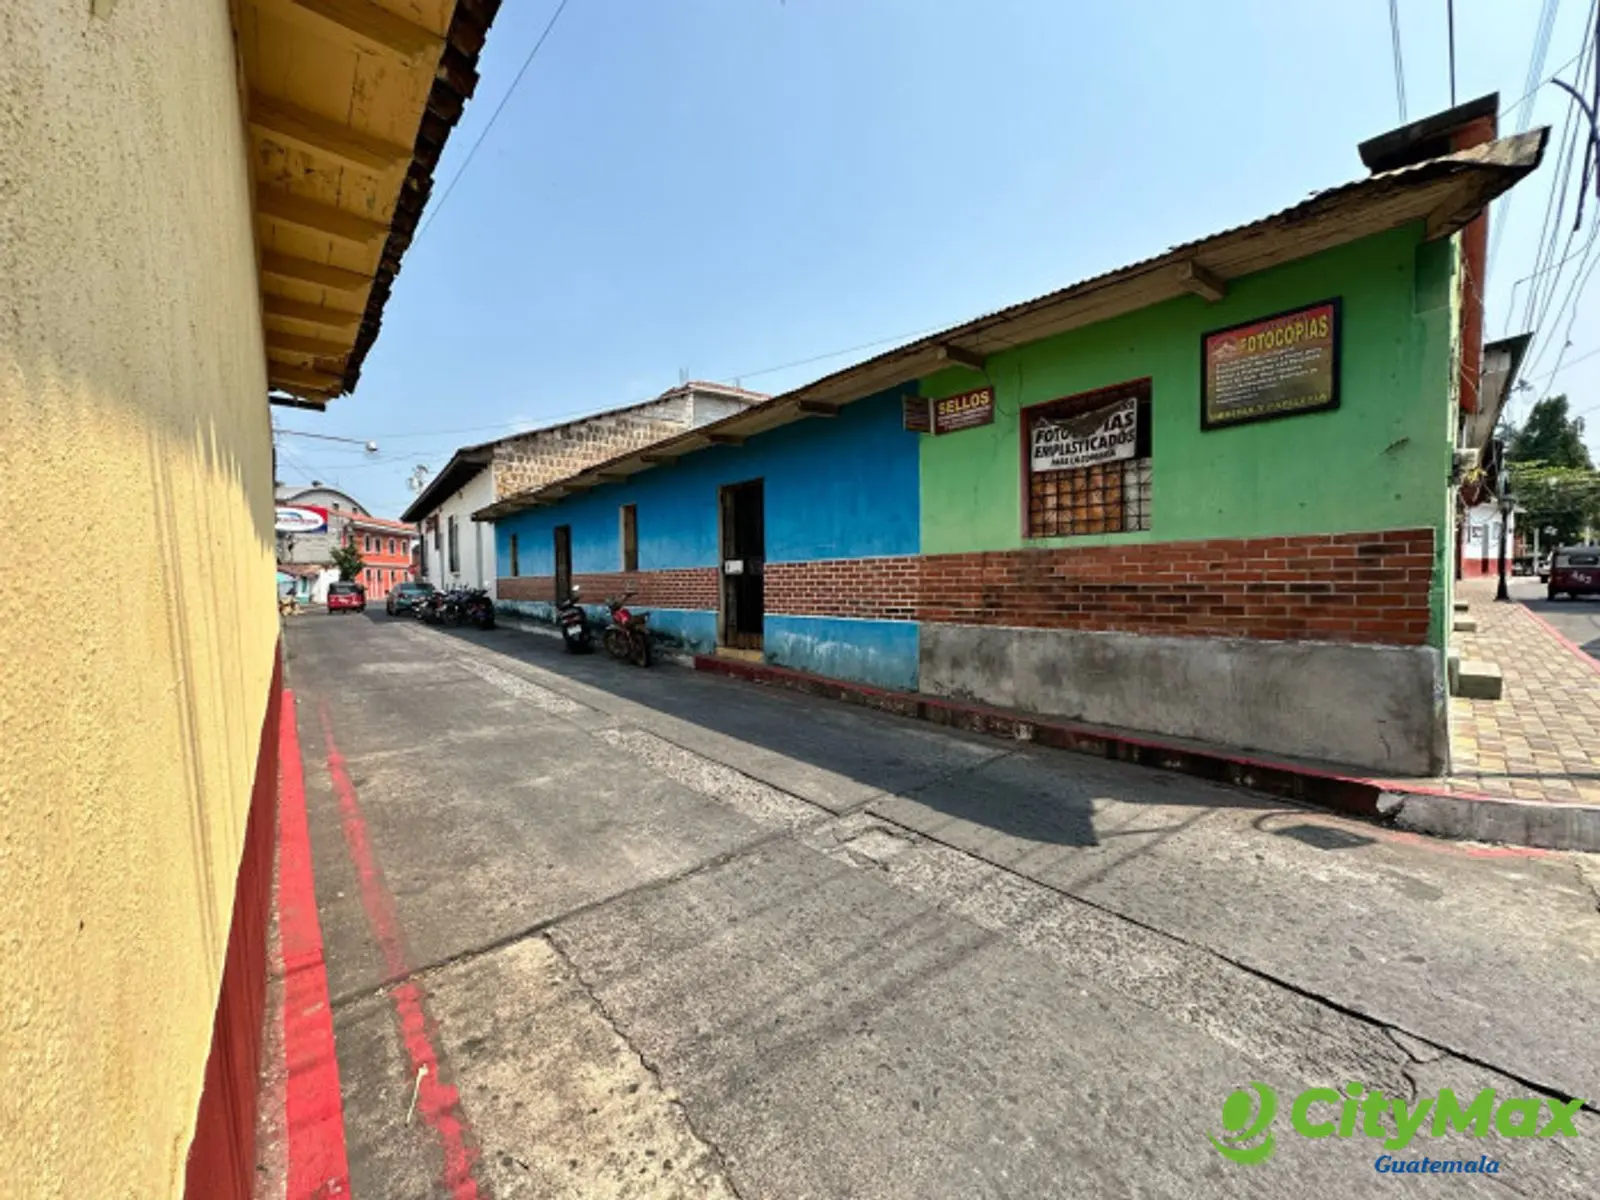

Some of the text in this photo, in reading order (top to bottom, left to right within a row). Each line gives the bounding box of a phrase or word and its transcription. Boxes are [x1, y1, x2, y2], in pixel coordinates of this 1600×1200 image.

[1239, 314, 1329, 353] FOTOCOPIAS
[938, 391, 990, 415] SELLOS
[1035, 411, 1134, 444] FOTOIAS
